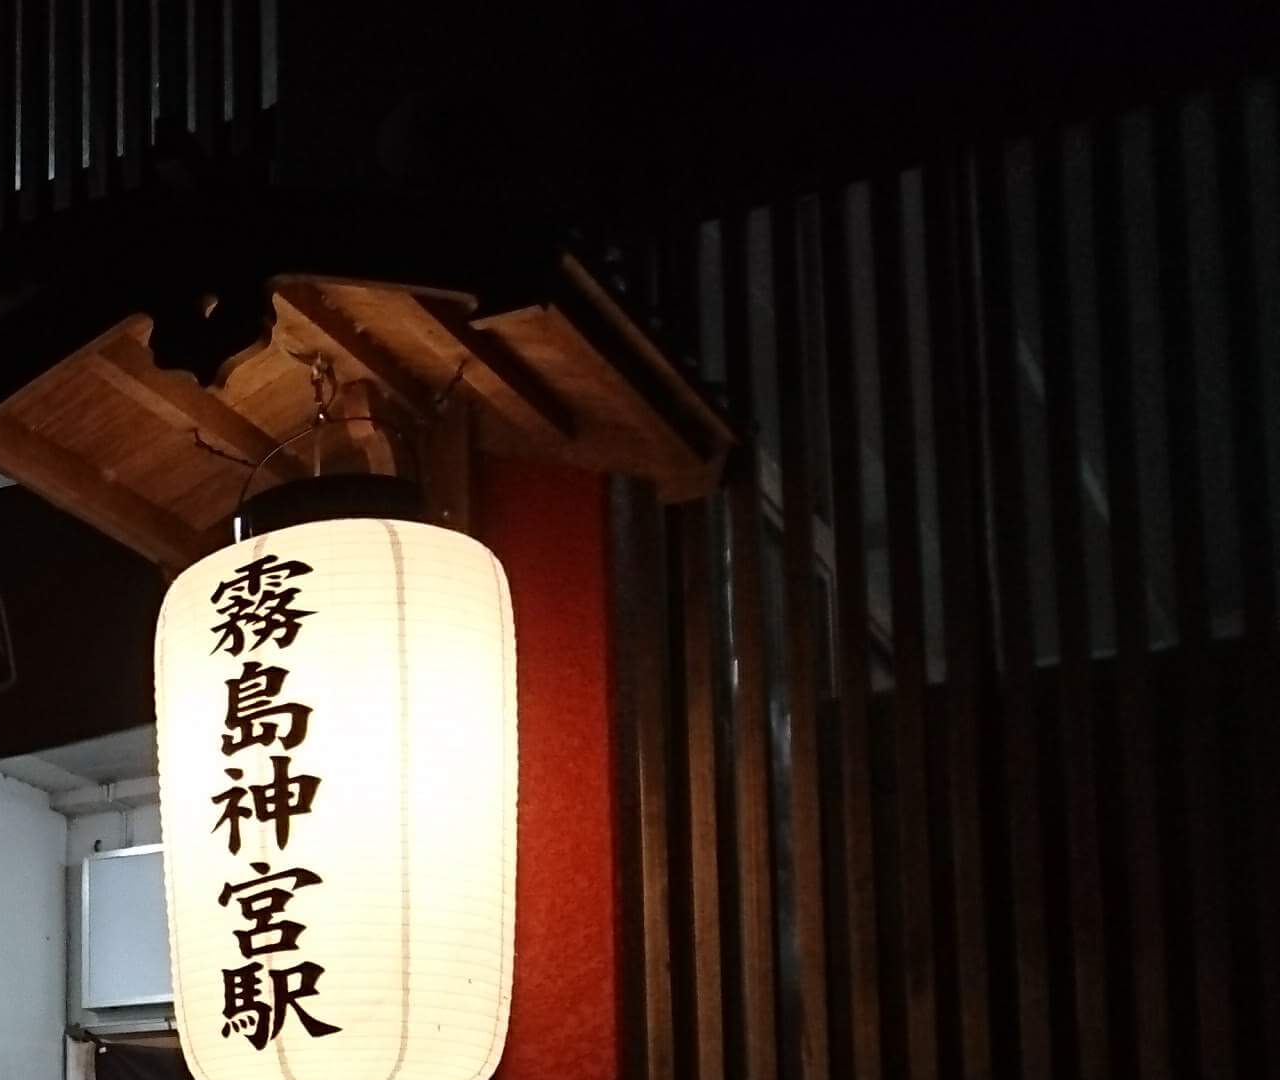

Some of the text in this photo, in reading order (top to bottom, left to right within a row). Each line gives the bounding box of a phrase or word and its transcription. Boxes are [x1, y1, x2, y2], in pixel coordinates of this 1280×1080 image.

[209, 555, 343, 1050] 霧島神宮駅
